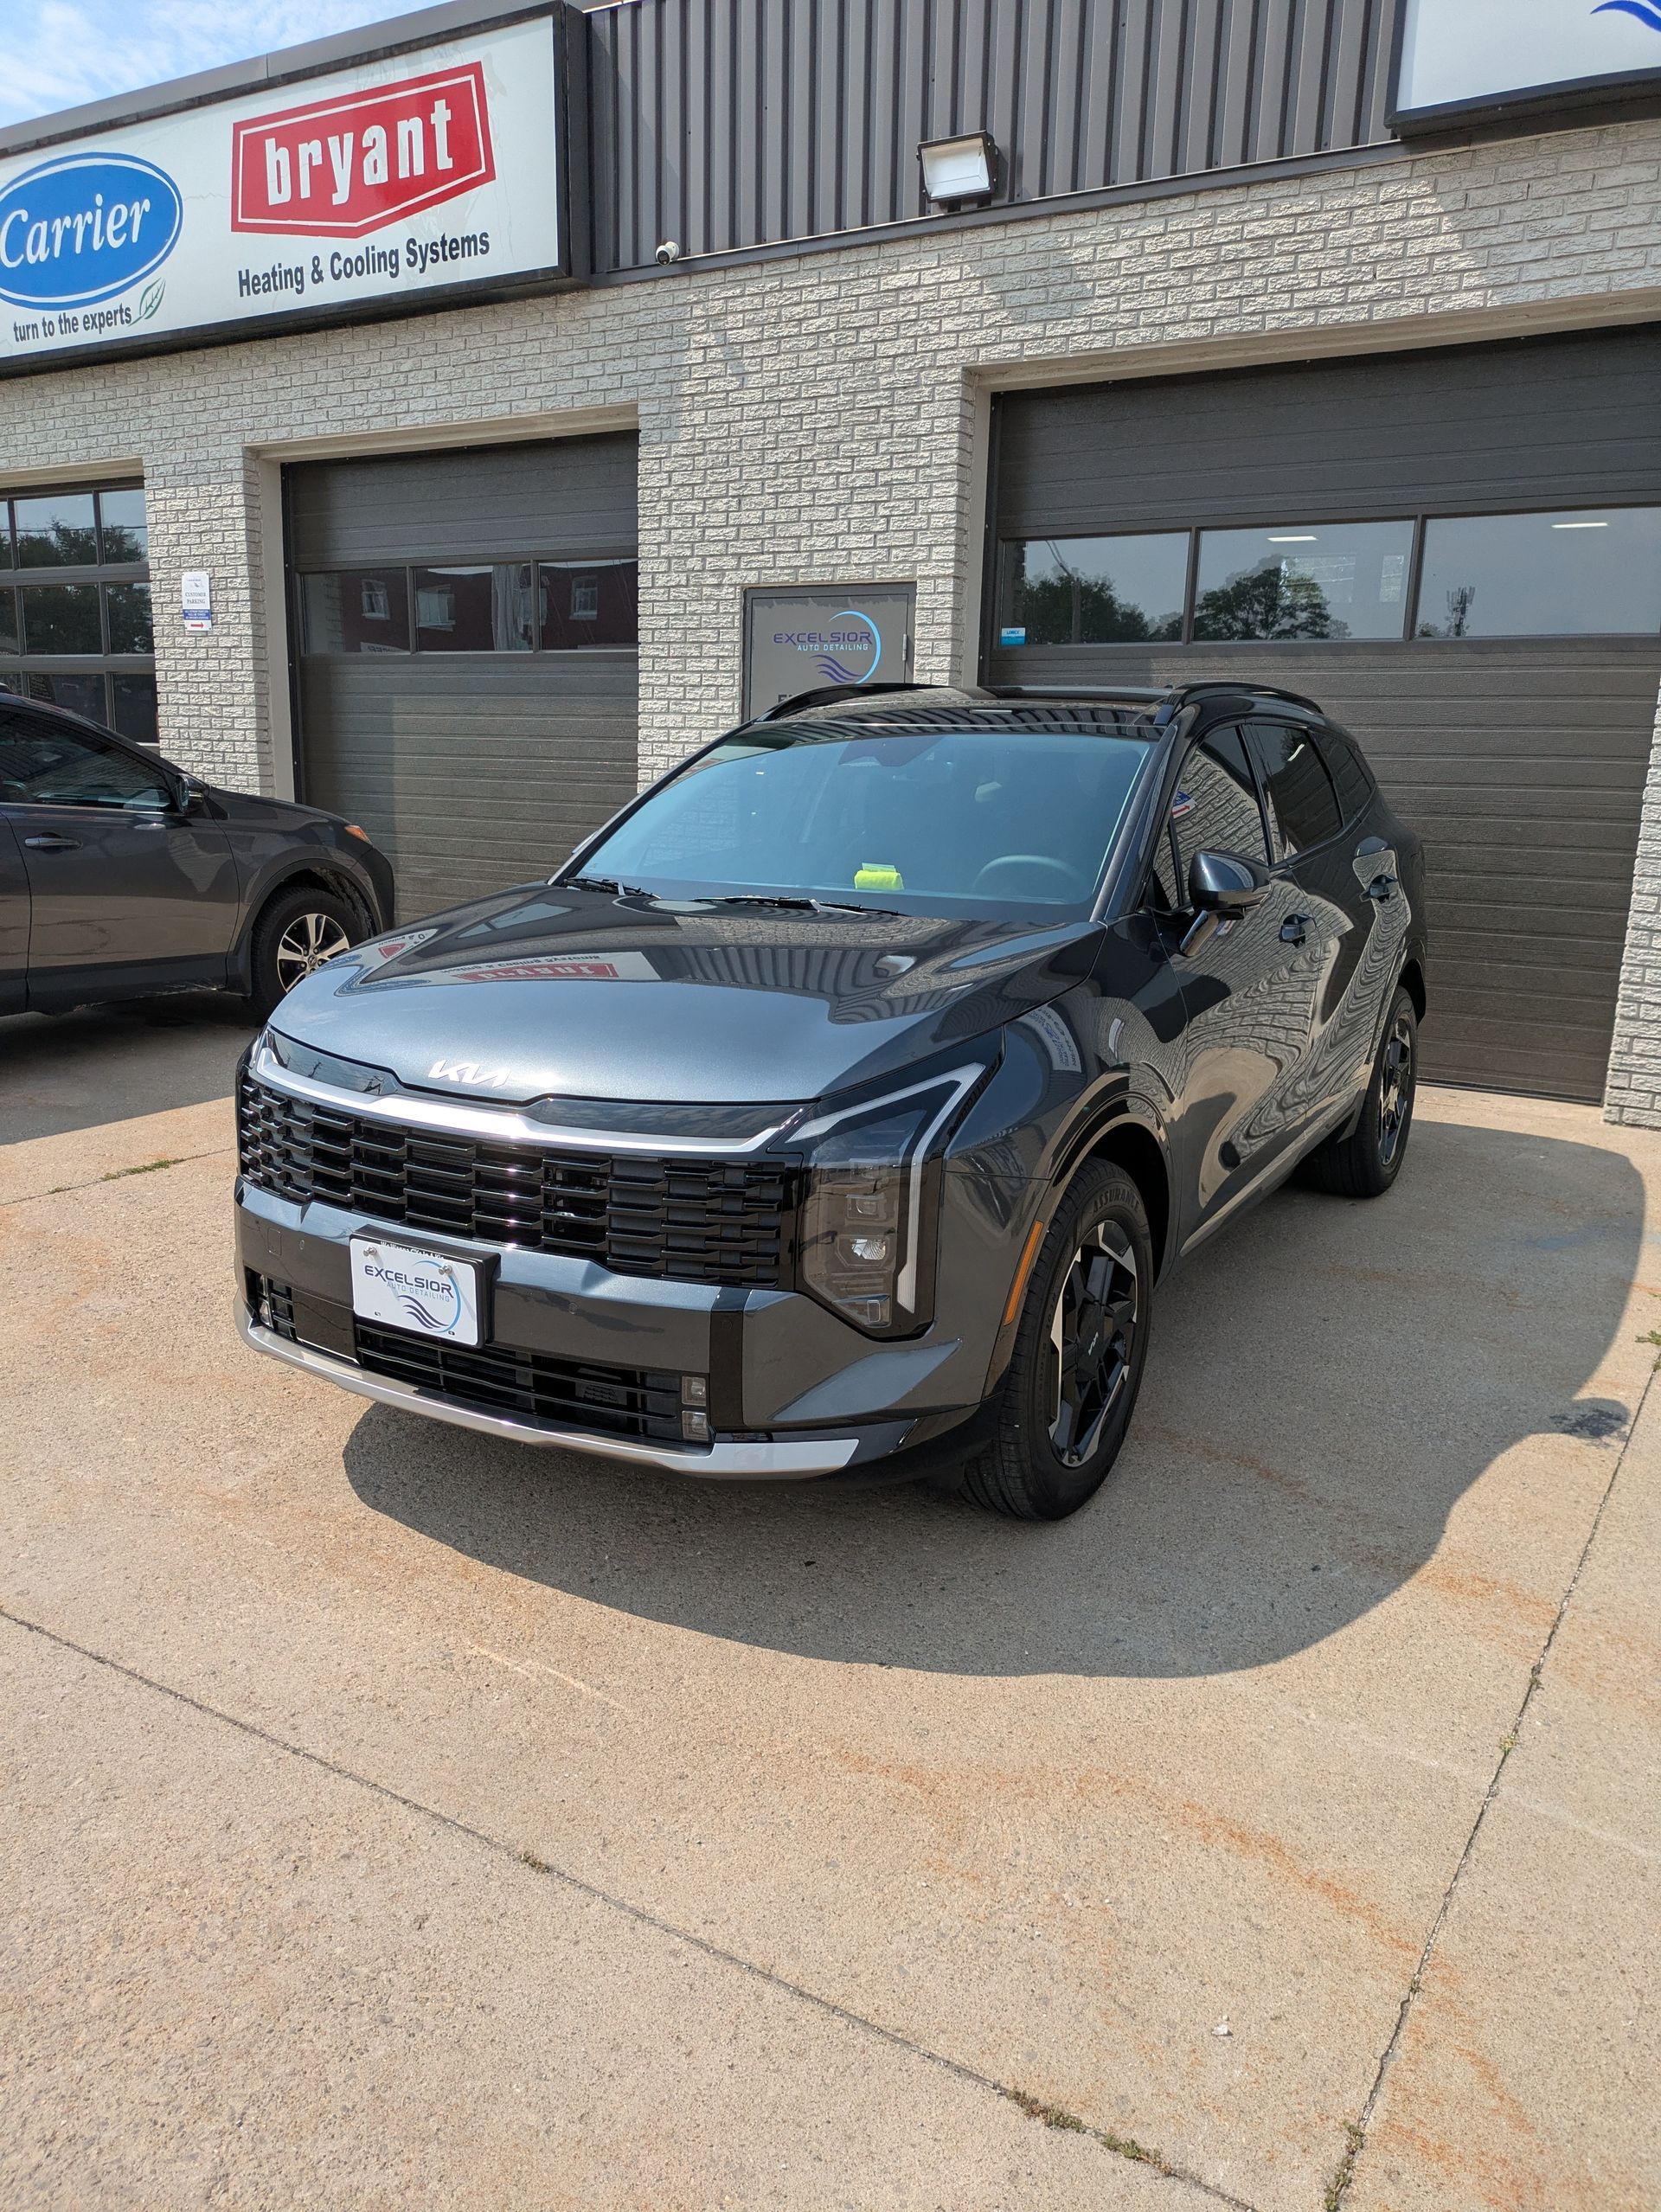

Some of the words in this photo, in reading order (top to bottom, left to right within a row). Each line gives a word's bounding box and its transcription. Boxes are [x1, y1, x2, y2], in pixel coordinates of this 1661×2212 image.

[265, 99, 453, 206] bryant
[0, 193, 151, 268] Carrier
[238, 263, 304, 298] Heating
[311, 255, 324, 285] &
[330, 245, 400, 279] Cooling
[406, 232, 490, 273] Systems
[13, 321, 39, 343] turn
[42, 316, 55, 337] to
[58, 312, 79, 336] the
[82, 303, 132, 334] experts
[773, 632, 873, 645] EXCELSIOR
[364, 1265, 454, 1298] EXCELSIOR
[387, 1282, 407, 1292] AUTO
[409, 1286, 451, 1303] DETAILING
